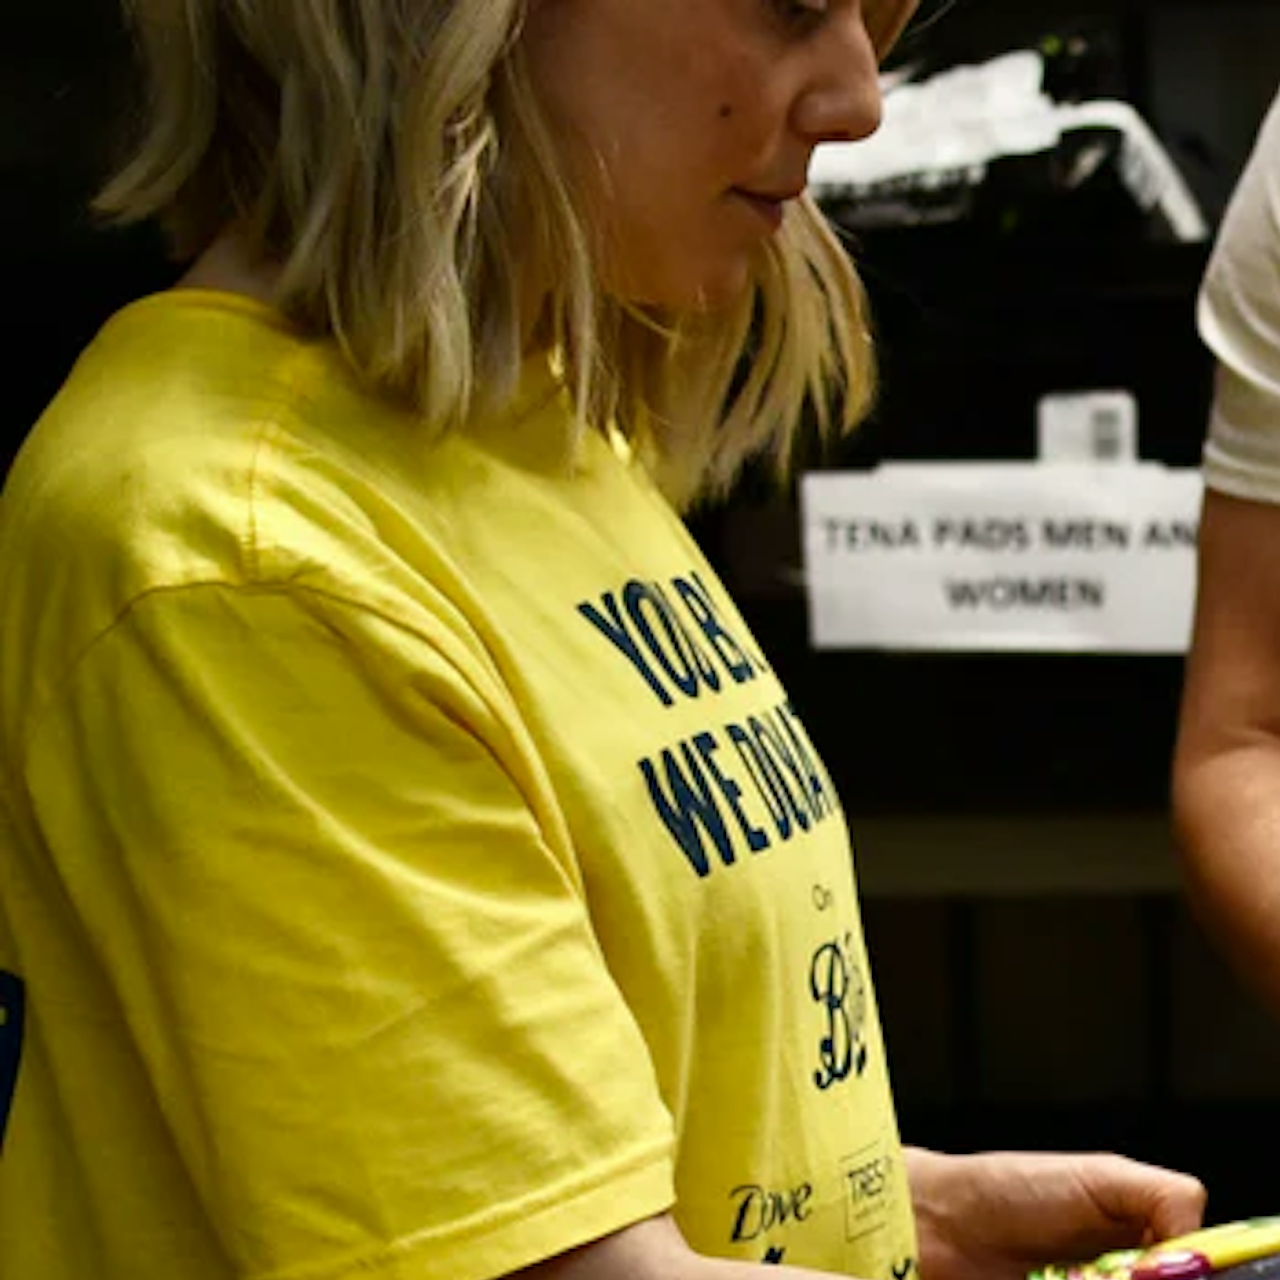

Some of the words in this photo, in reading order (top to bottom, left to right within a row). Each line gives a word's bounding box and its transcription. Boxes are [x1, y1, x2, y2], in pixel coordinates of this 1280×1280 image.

[821, 518, 920, 551] TENA
[933, 518, 1030, 551] PADS
[1043, 518, 1130, 551] MEN
[1144, 518, 1198, 551] AN
[945, 577, 1106, 611] WOMEN
[637, 731, 771, 878] WE
[728, 1181, 813, 1243] Dove
